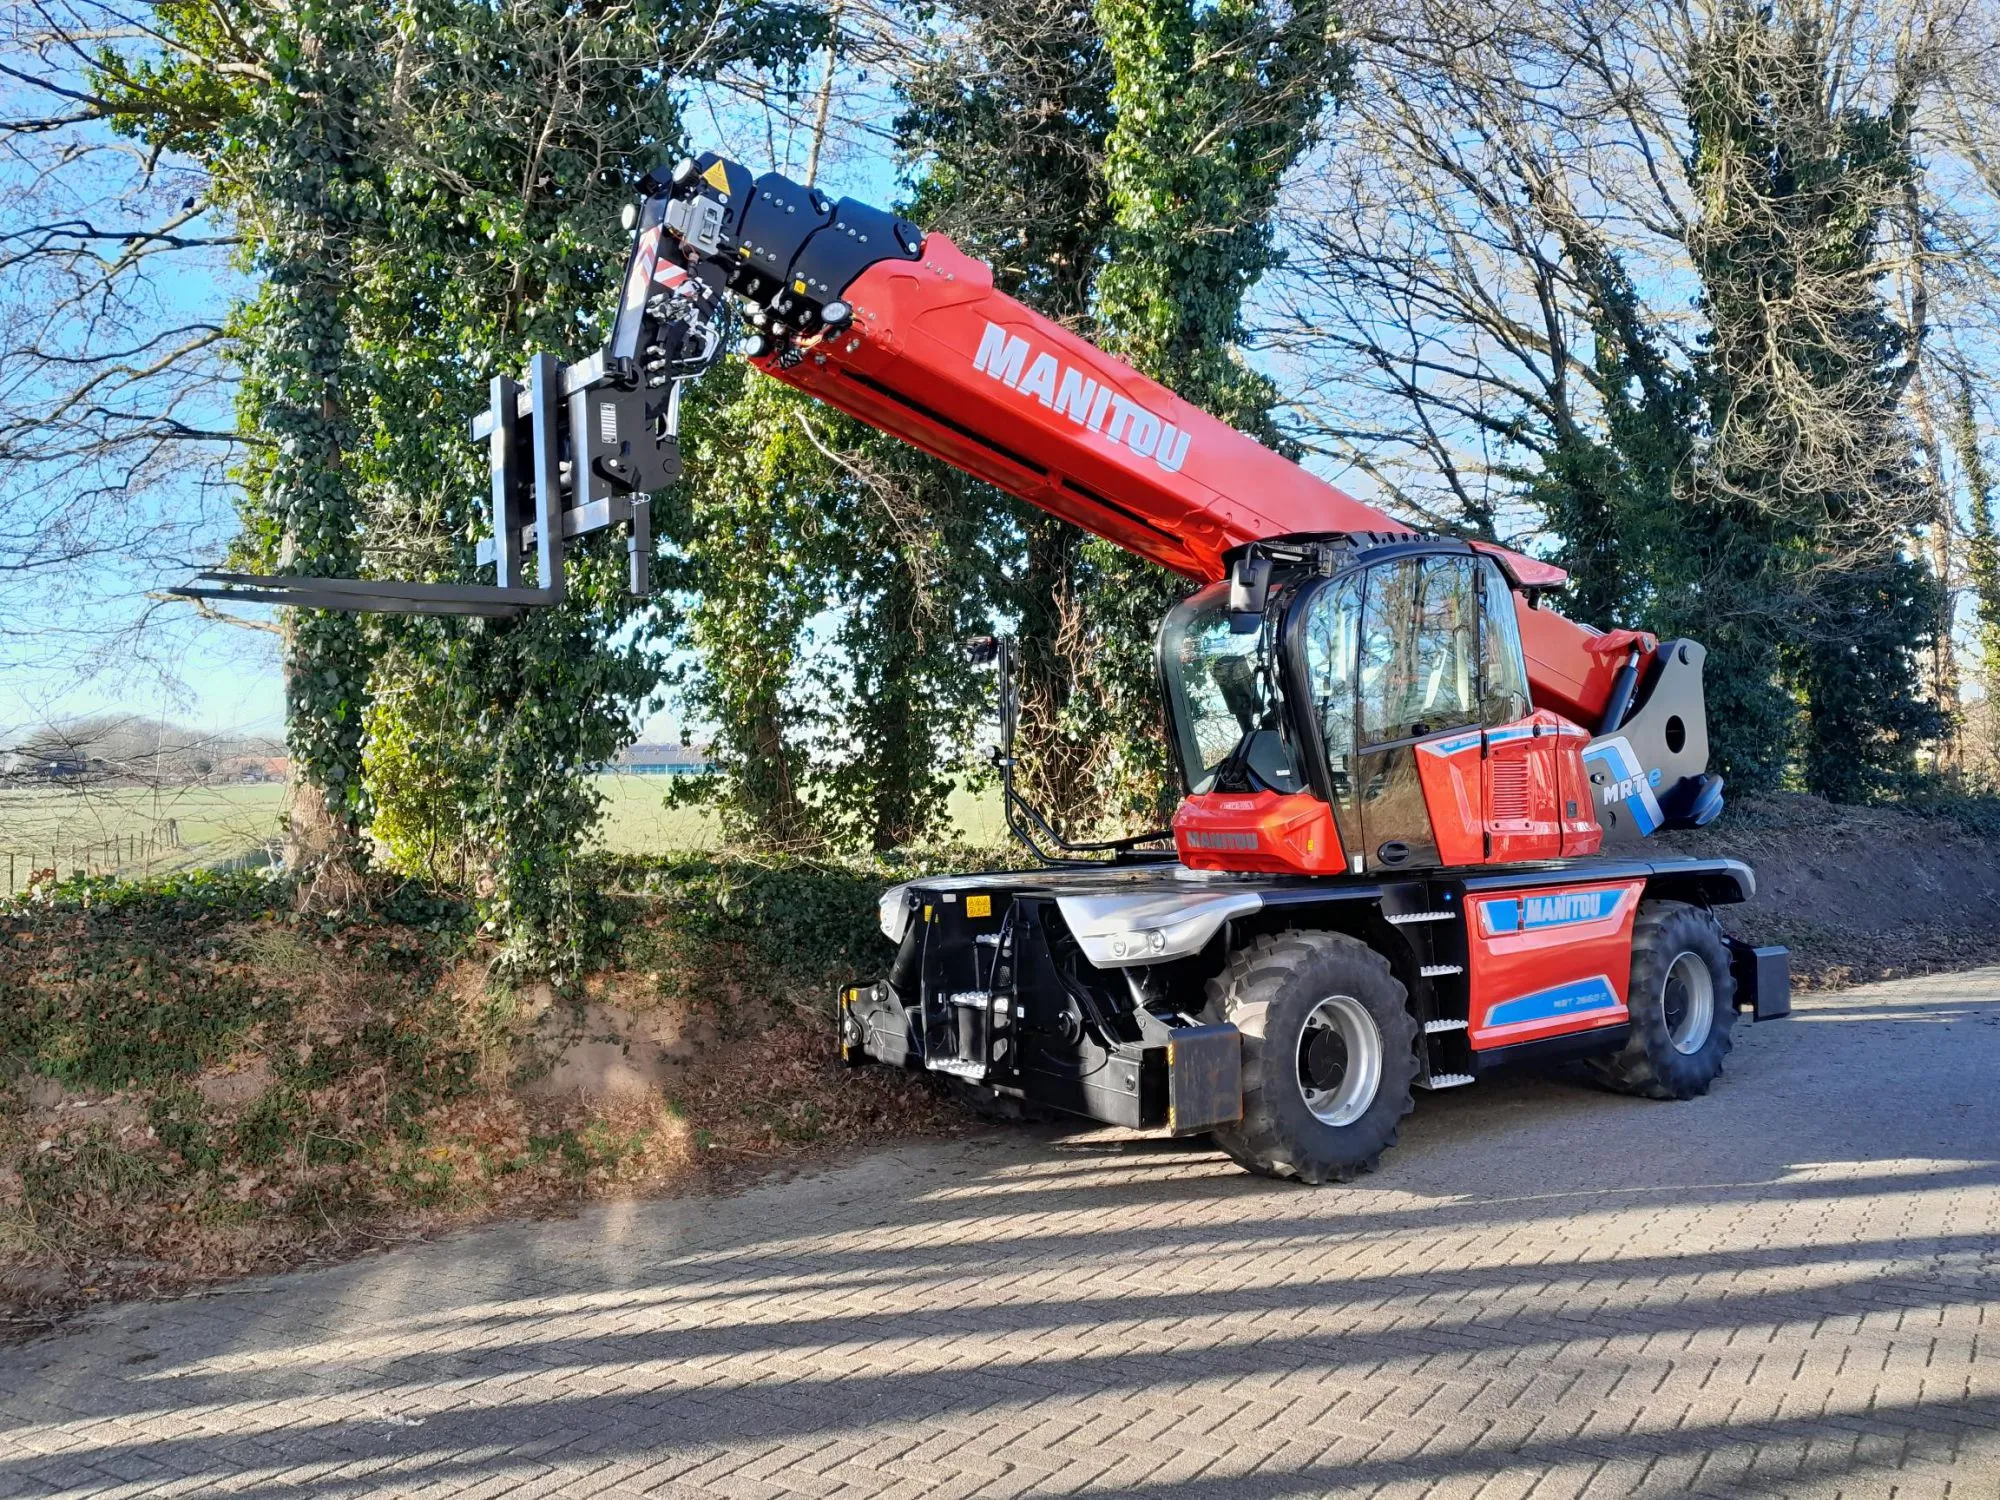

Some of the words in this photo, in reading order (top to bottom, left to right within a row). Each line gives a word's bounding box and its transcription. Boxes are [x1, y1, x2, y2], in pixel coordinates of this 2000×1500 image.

[972, 321, 1192, 472] MANITOU
[1603, 773, 1645, 805] MRT
[1186, 831, 1258, 849] MANITOU
[1525, 893, 1600, 922] MANITOU
